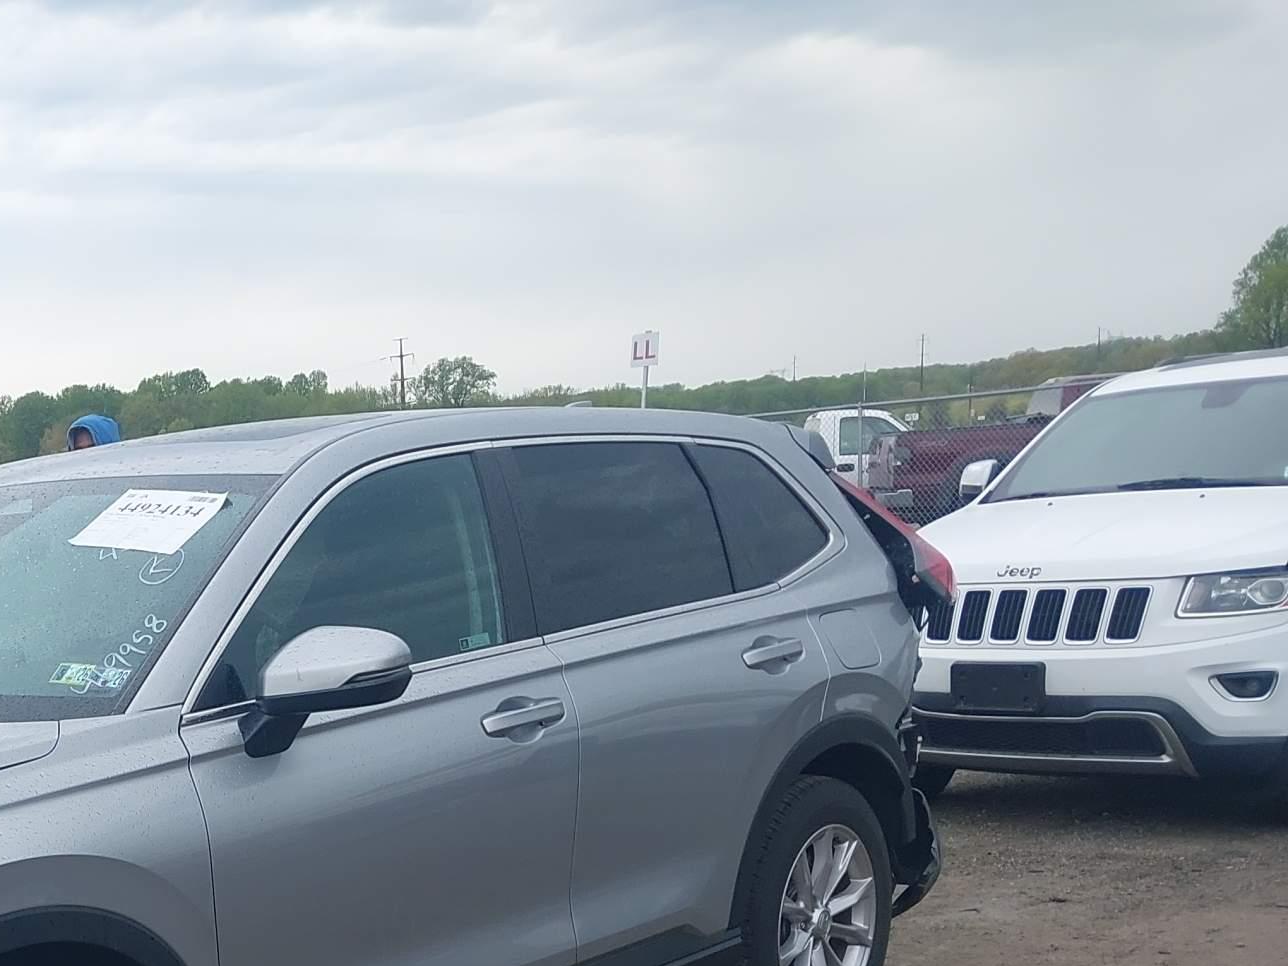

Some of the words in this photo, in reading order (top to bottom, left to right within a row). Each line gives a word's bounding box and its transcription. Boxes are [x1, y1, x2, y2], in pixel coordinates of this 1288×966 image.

[633, 339, 656, 360] LL
[118, 502, 206, 517] 44924134
[996, 564, 1042, 580] Jeep
